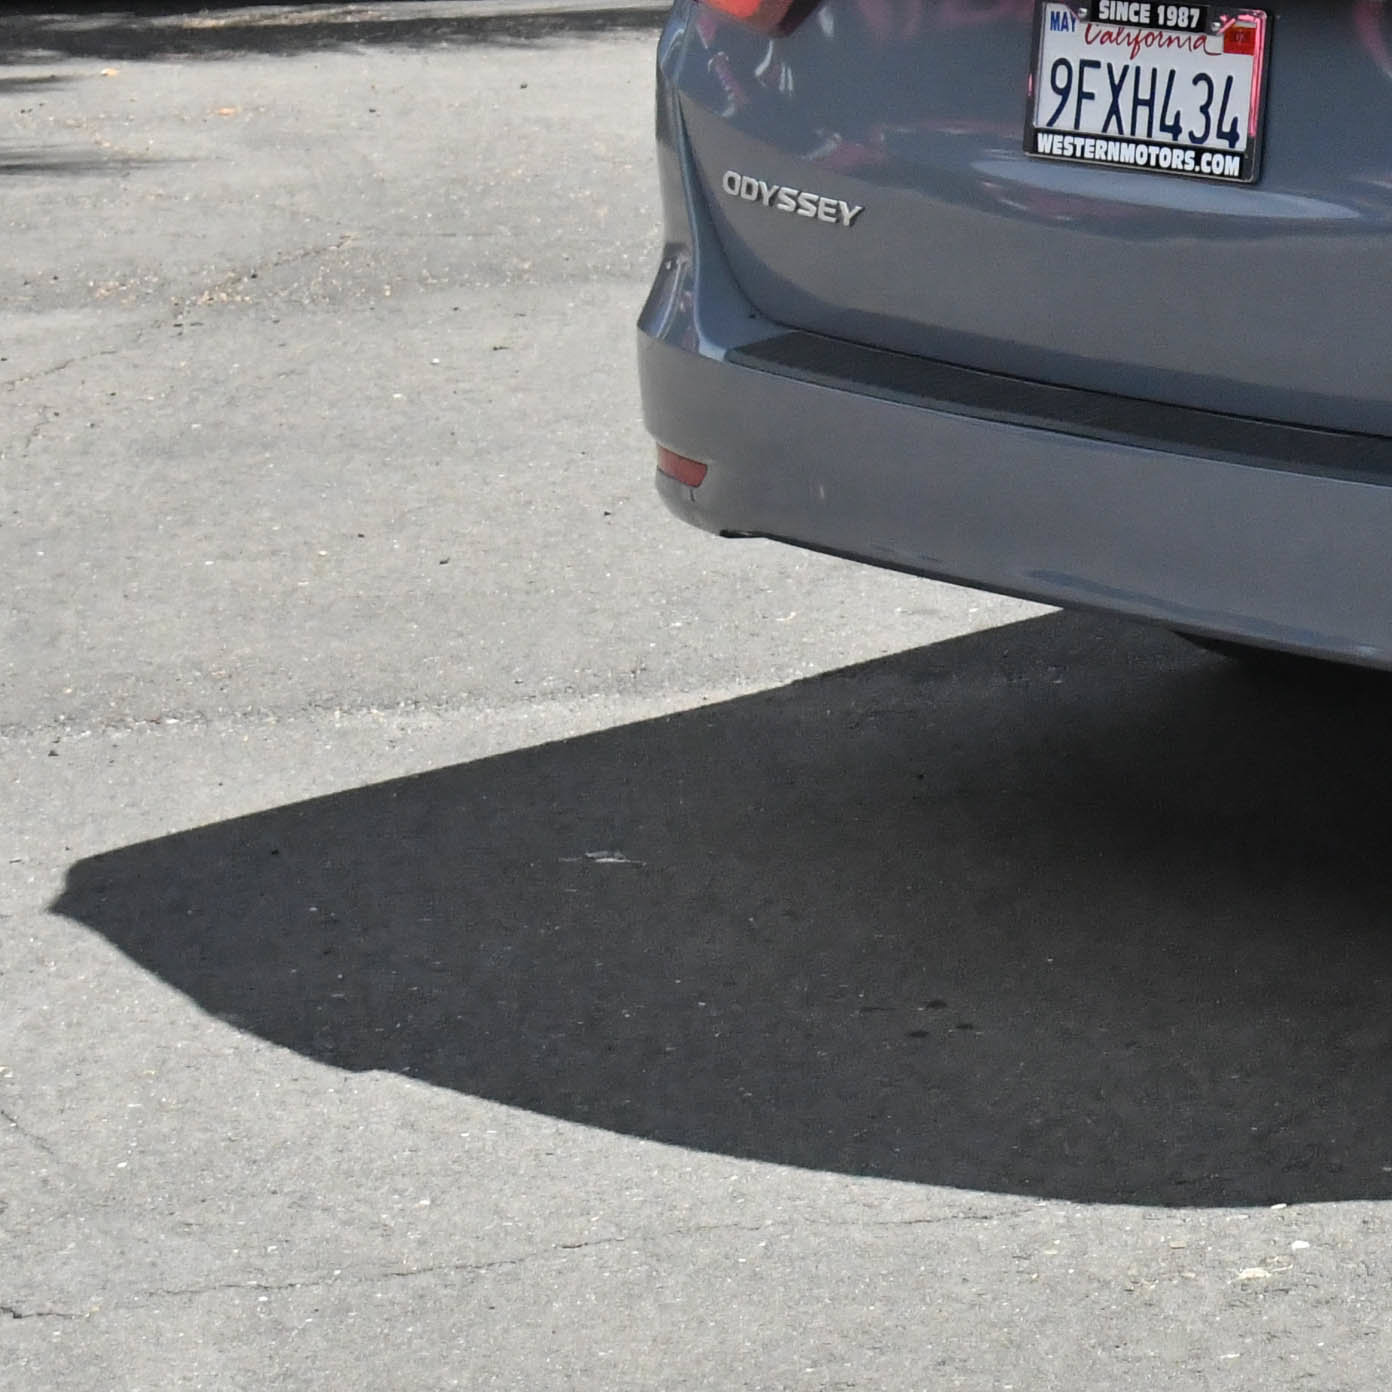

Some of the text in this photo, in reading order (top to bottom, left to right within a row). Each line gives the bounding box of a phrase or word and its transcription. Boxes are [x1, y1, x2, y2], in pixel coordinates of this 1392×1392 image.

[1050, 10, 1078, 33] MAY
[1157, 4, 1200, 28] 1987
[1084, 22, 1222, 60] California
[1046, 57, 1240, 149] 9FXH434
[1037, 132, 1241, 177] WESTERNMOTORS.COM
[722, 170, 864, 226] ODYSSEY
